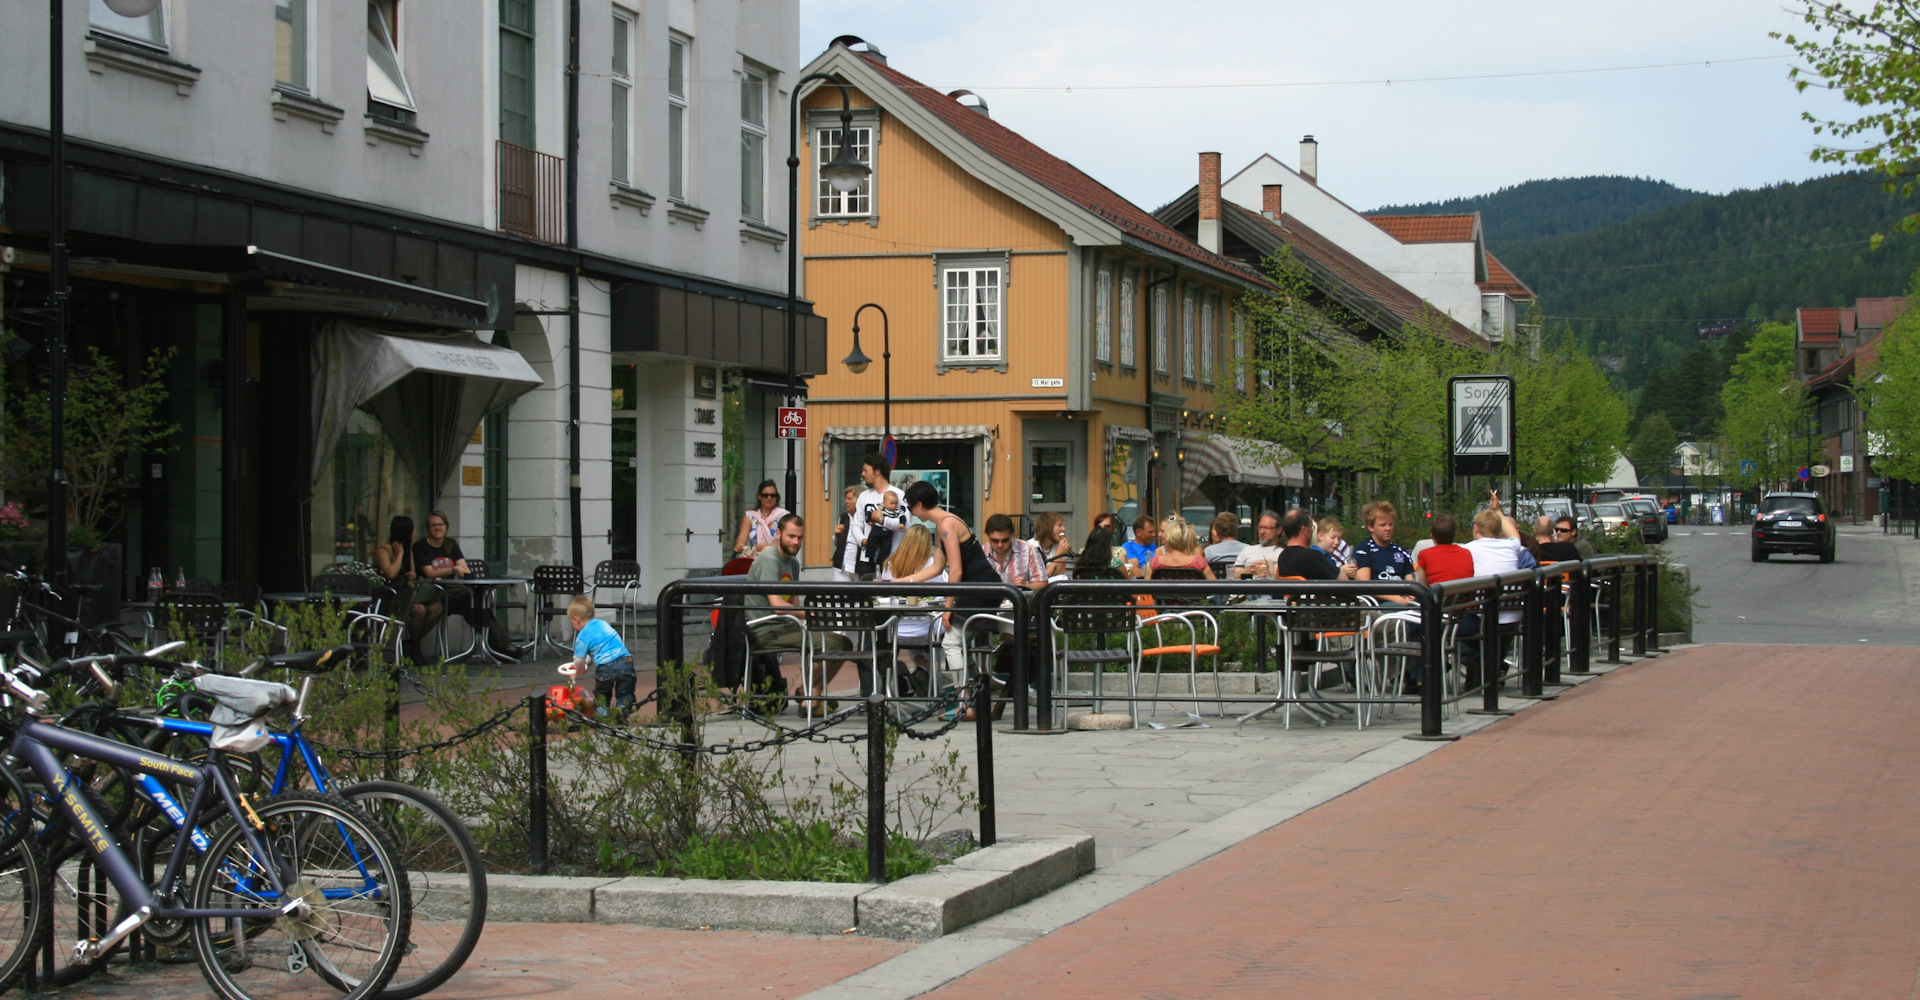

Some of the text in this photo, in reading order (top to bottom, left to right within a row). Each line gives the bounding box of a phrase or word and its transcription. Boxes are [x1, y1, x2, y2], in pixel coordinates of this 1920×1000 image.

[1464, 386, 1499, 399] Sone
[695, 408, 715, 424] DAME
[694, 442, 716, 457] HERRE
[695, 477, 716, 493] JEANS
[139, 756, 195, 778] South Face
[52, 773, 109, 853] YOSEMITE
